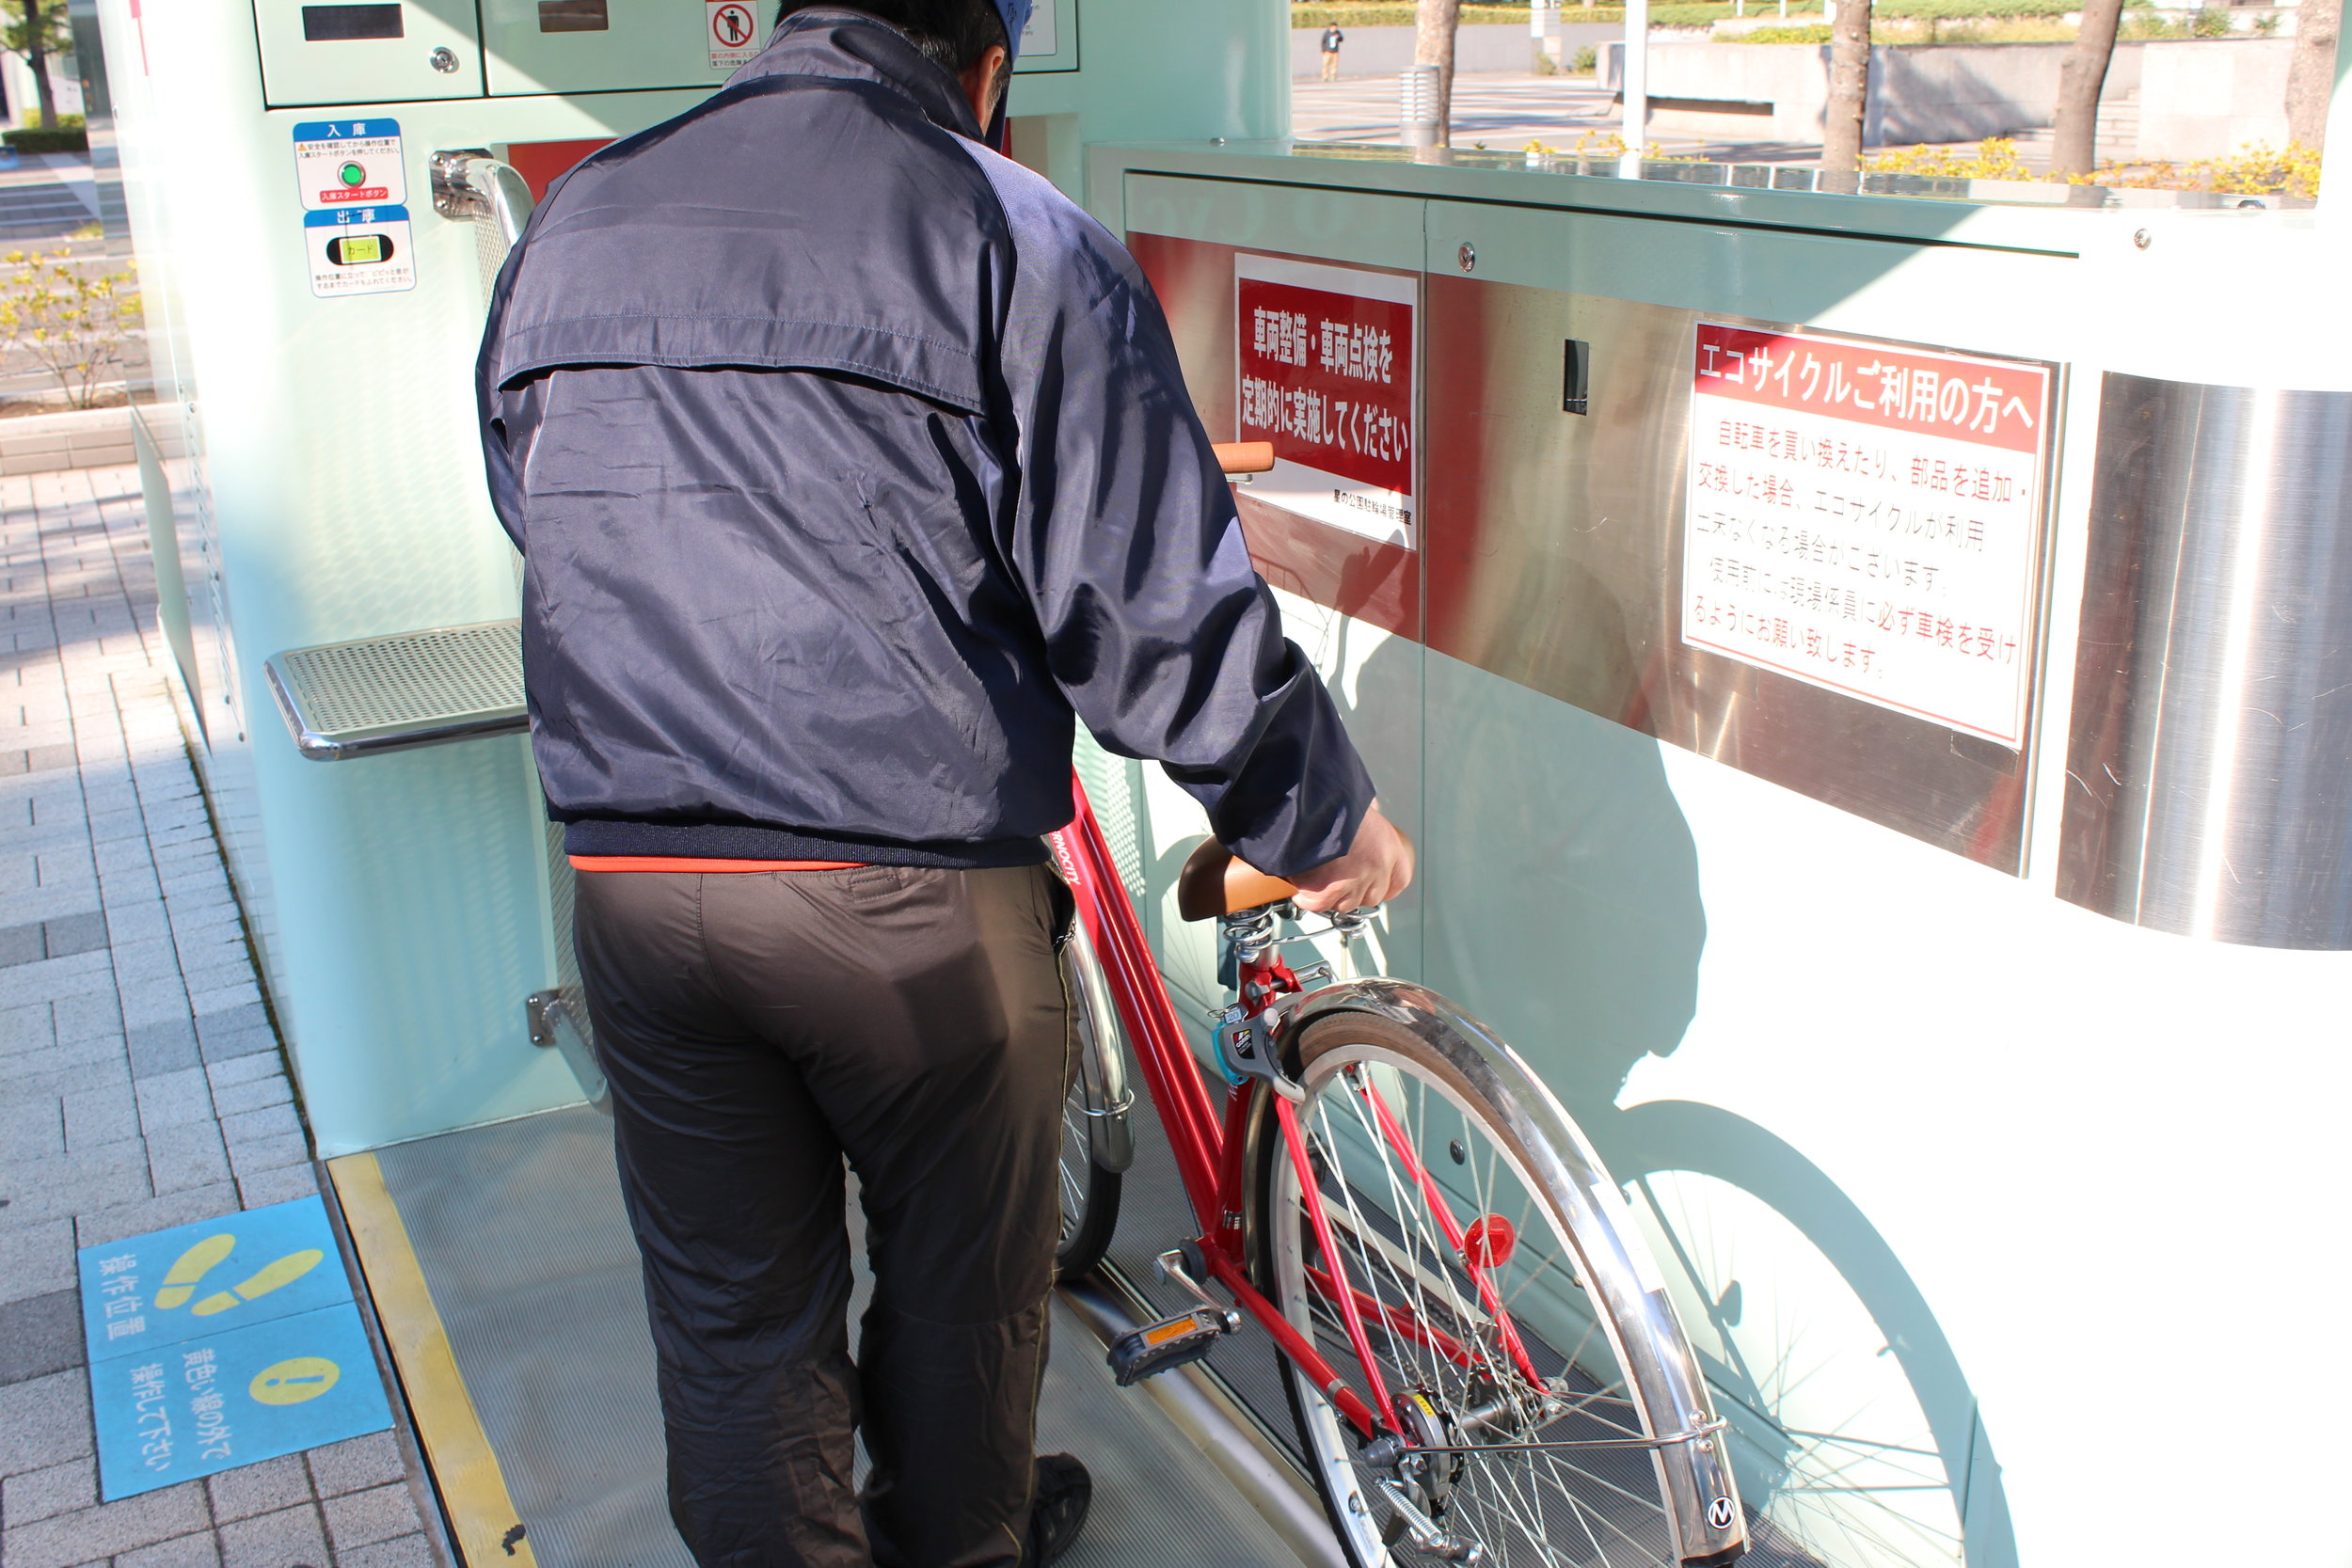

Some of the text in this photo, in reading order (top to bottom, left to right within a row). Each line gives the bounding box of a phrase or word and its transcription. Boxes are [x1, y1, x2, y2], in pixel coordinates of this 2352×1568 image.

[327, 122, 367, 137] 入庫
[322, 189, 388, 201] 入庫スタートボタン
[337, 208, 375, 223] 出庫
[348, 245, 373, 255] カード
[1253, 306, 1392, 384] 車両整備・車両点検を
[1242, 374, 1408, 462] 定期的に実施してください
[1699, 343, 2034, 435] エコサイクルご利用の方へ
[1698, 460, 1984, 553] 交換した場合、エコサイクルが利用
[1694, 594, 1883, 679] るようにお願い致します。
[1228, 1011, 1240, 1022] 20
[99, 1254, 146, 1340] 操作位置
[130, 1363, 175, 1472] 操作して下さい
[182, 1348, 231, 1460] 黄色い線の外で
